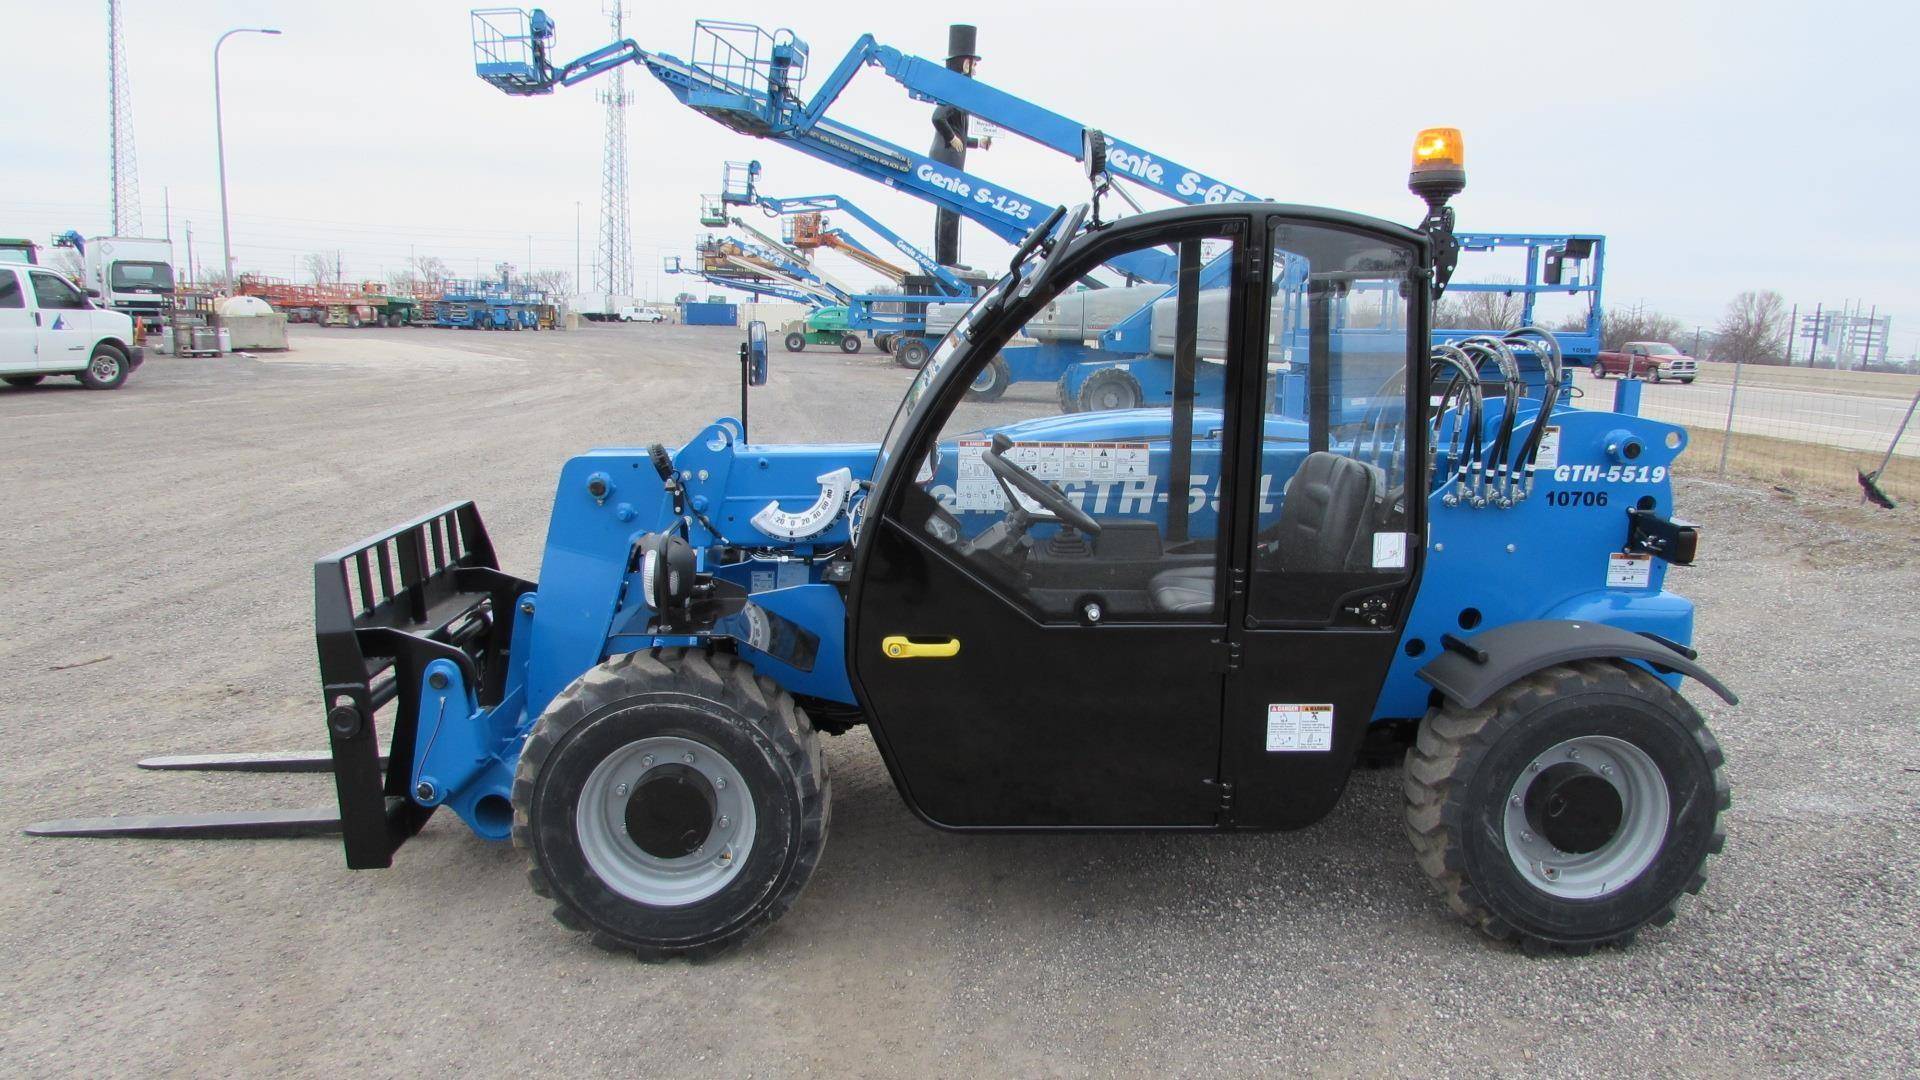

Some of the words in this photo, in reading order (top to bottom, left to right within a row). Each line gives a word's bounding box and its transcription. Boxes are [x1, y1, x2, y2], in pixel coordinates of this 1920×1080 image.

[917, 164, 970, 198] Genie
[973, 188, 1032, 220] S-125
[896, 240, 916, 258] Genie
[1554, 464, 1666, 484] GTH-5519
[1546, 491, 1608, 507] 10706
